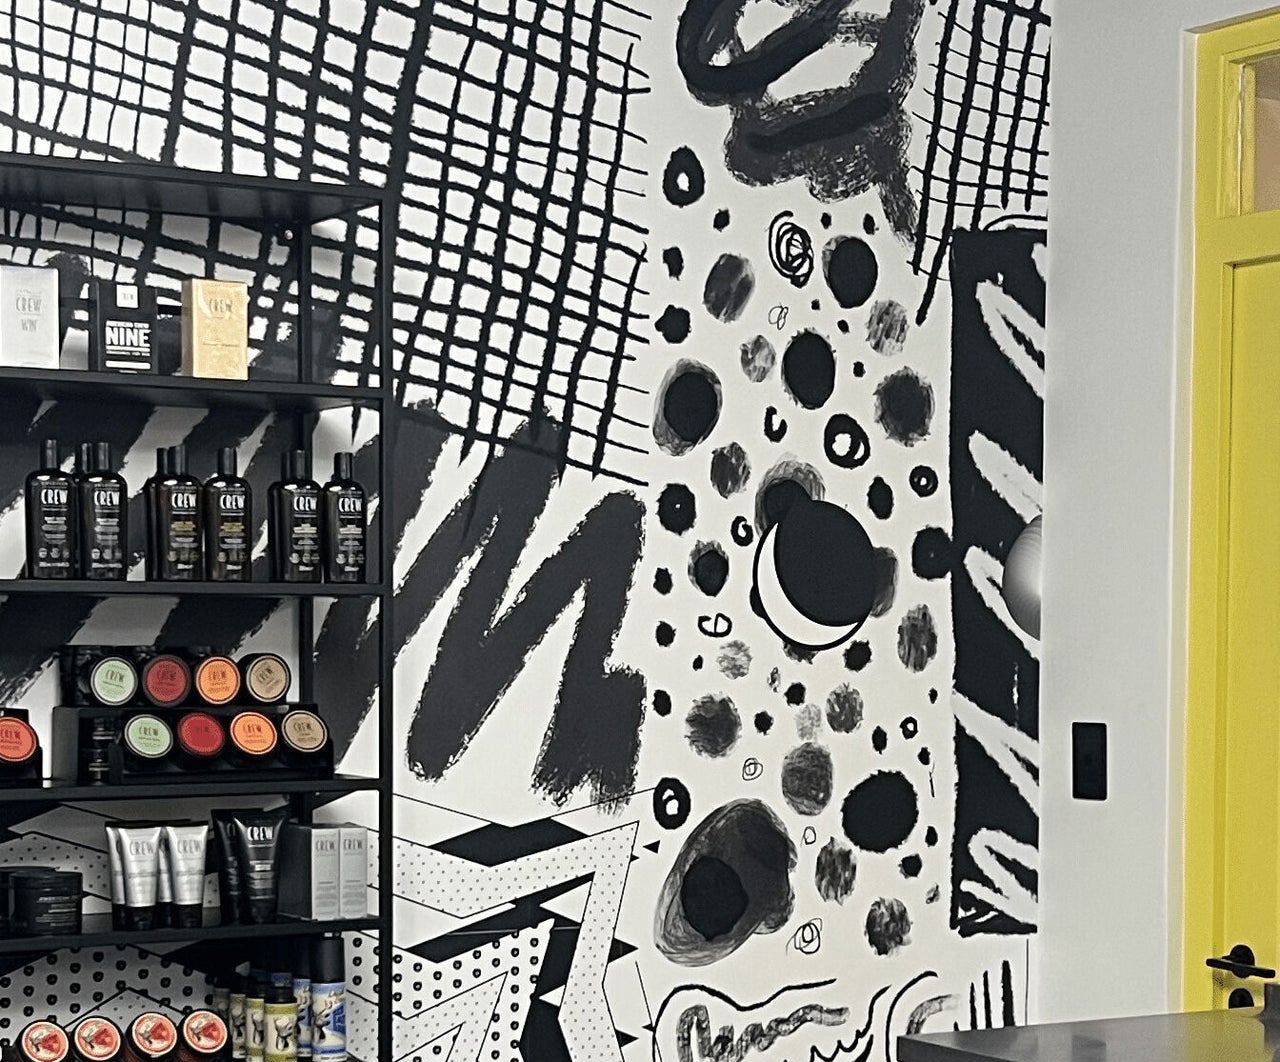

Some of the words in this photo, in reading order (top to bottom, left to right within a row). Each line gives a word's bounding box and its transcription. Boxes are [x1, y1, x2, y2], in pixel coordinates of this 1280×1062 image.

[106, 327, 151, 348] NINE
[41, 489, 68, 505] CREW
[94, 491, 120, 506] CREW
[171, 493, 197, 509] CREW
[220, 494, 246, 510] CREW
[294, 496, 318, 511] CREW
[339, 497, 362, 512] CREW
[247, 826, 273, 841] CREW
